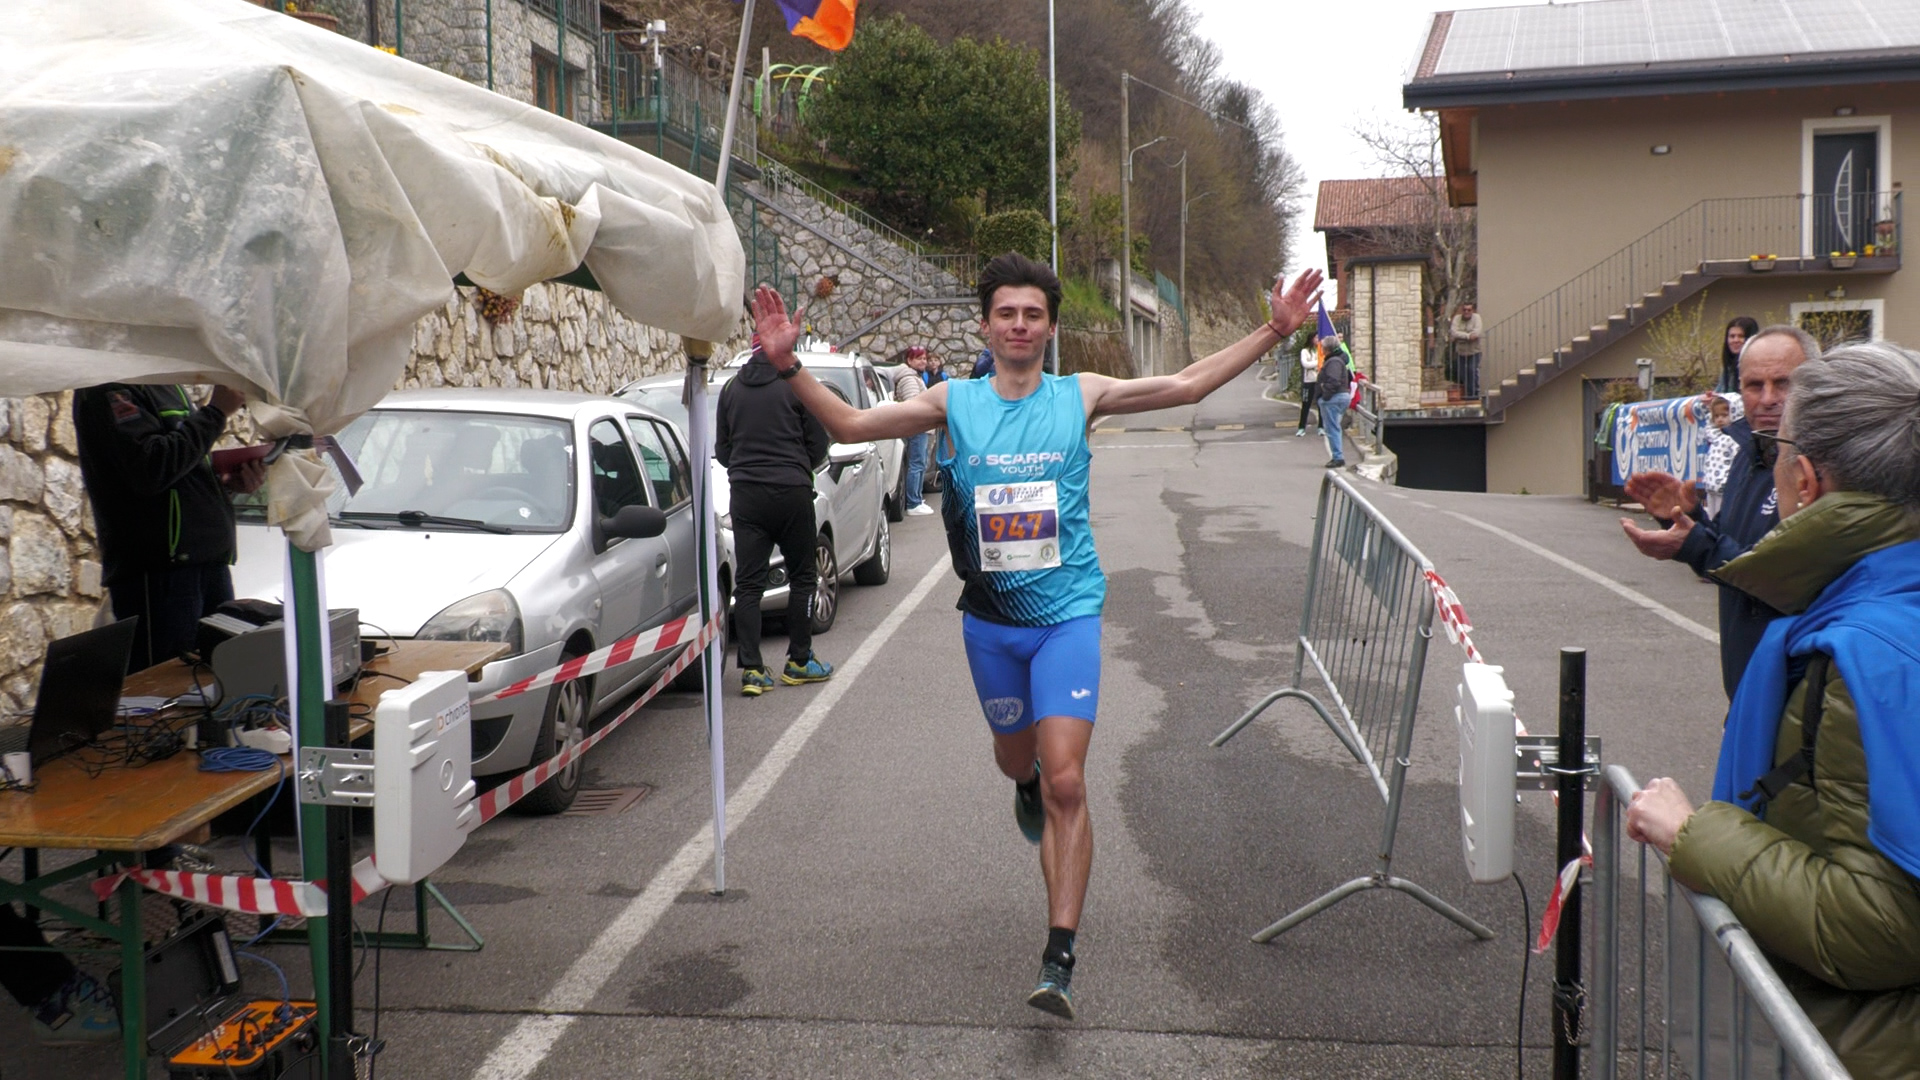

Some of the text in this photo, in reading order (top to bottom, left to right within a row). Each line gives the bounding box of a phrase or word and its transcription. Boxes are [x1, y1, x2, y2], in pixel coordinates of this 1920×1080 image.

[1639, 406, 1665, 427] CENTRO
[1638, 430, 1670, 449] SPORTIVO
[986, 452, 1063, 465] SCARPA
[1638, 454, 1669, 474] ITALIANO
[1000, 464, 1044, 474] YOUTH
[989, 513, 1043, 540] 947
